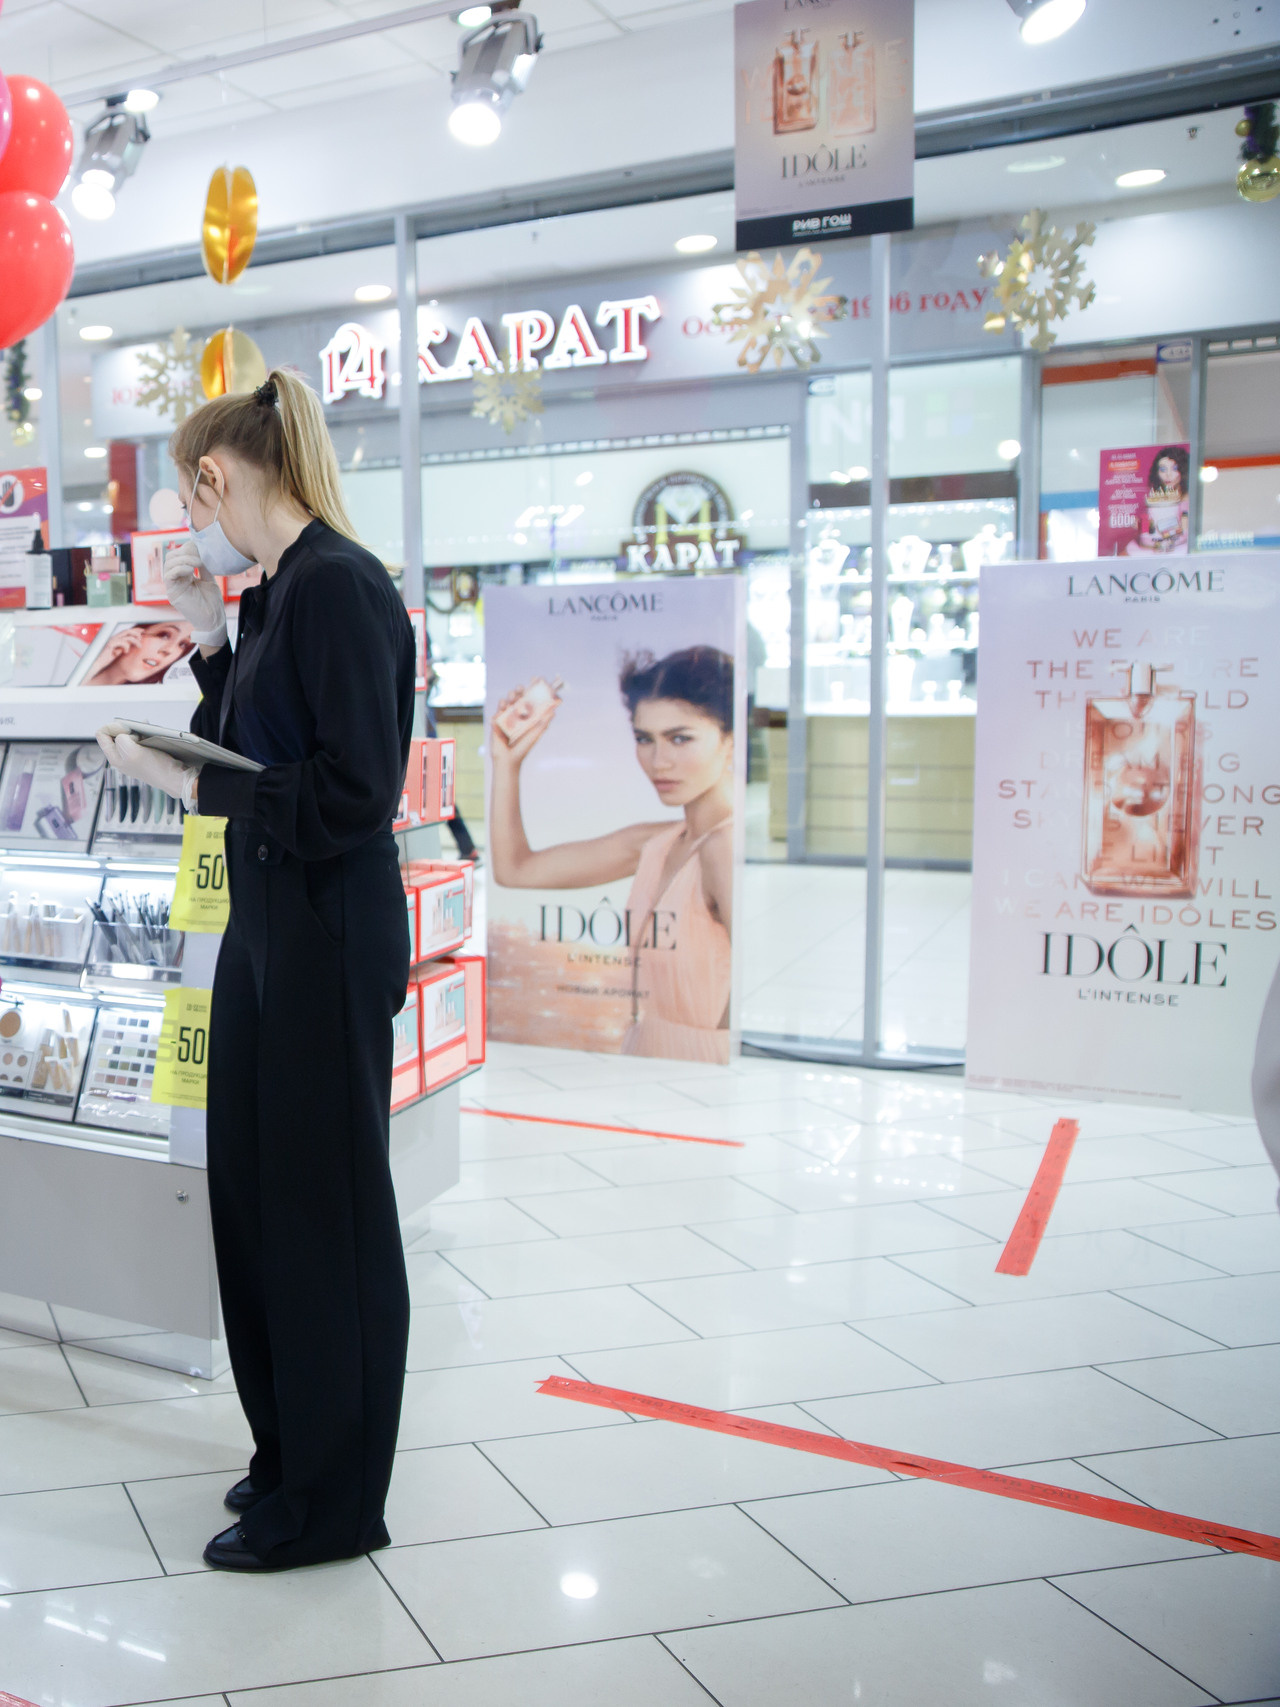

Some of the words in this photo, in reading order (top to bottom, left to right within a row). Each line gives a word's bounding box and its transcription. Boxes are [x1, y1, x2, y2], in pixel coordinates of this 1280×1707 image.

[781, 144, 868, 179] IDÔLE
[822, 213, 852, 228] ГОШ
[626, 539, 741, 574] КАРАТ
[1067, 567, 1225, 597] LANCÔME
[548, 589, 664, 615] LANCÔME
[1073, 628, 1122, 649] WE
[1027, 660, 1093, 679] THE
[539, 896, 677, 950] IDÔLE
[1054, 901, 1123, 923] ARE
[1140, 902, 1278, 931] IDÔLES
[567, 953, 642, 967] L'INTENSE
[1038, 923, 1228, 988] IDÔLE
[1078, 988, 1180, 1007] L'INTENSE
[177, 1070, 207, 1079] ПРОДУКЦИ
